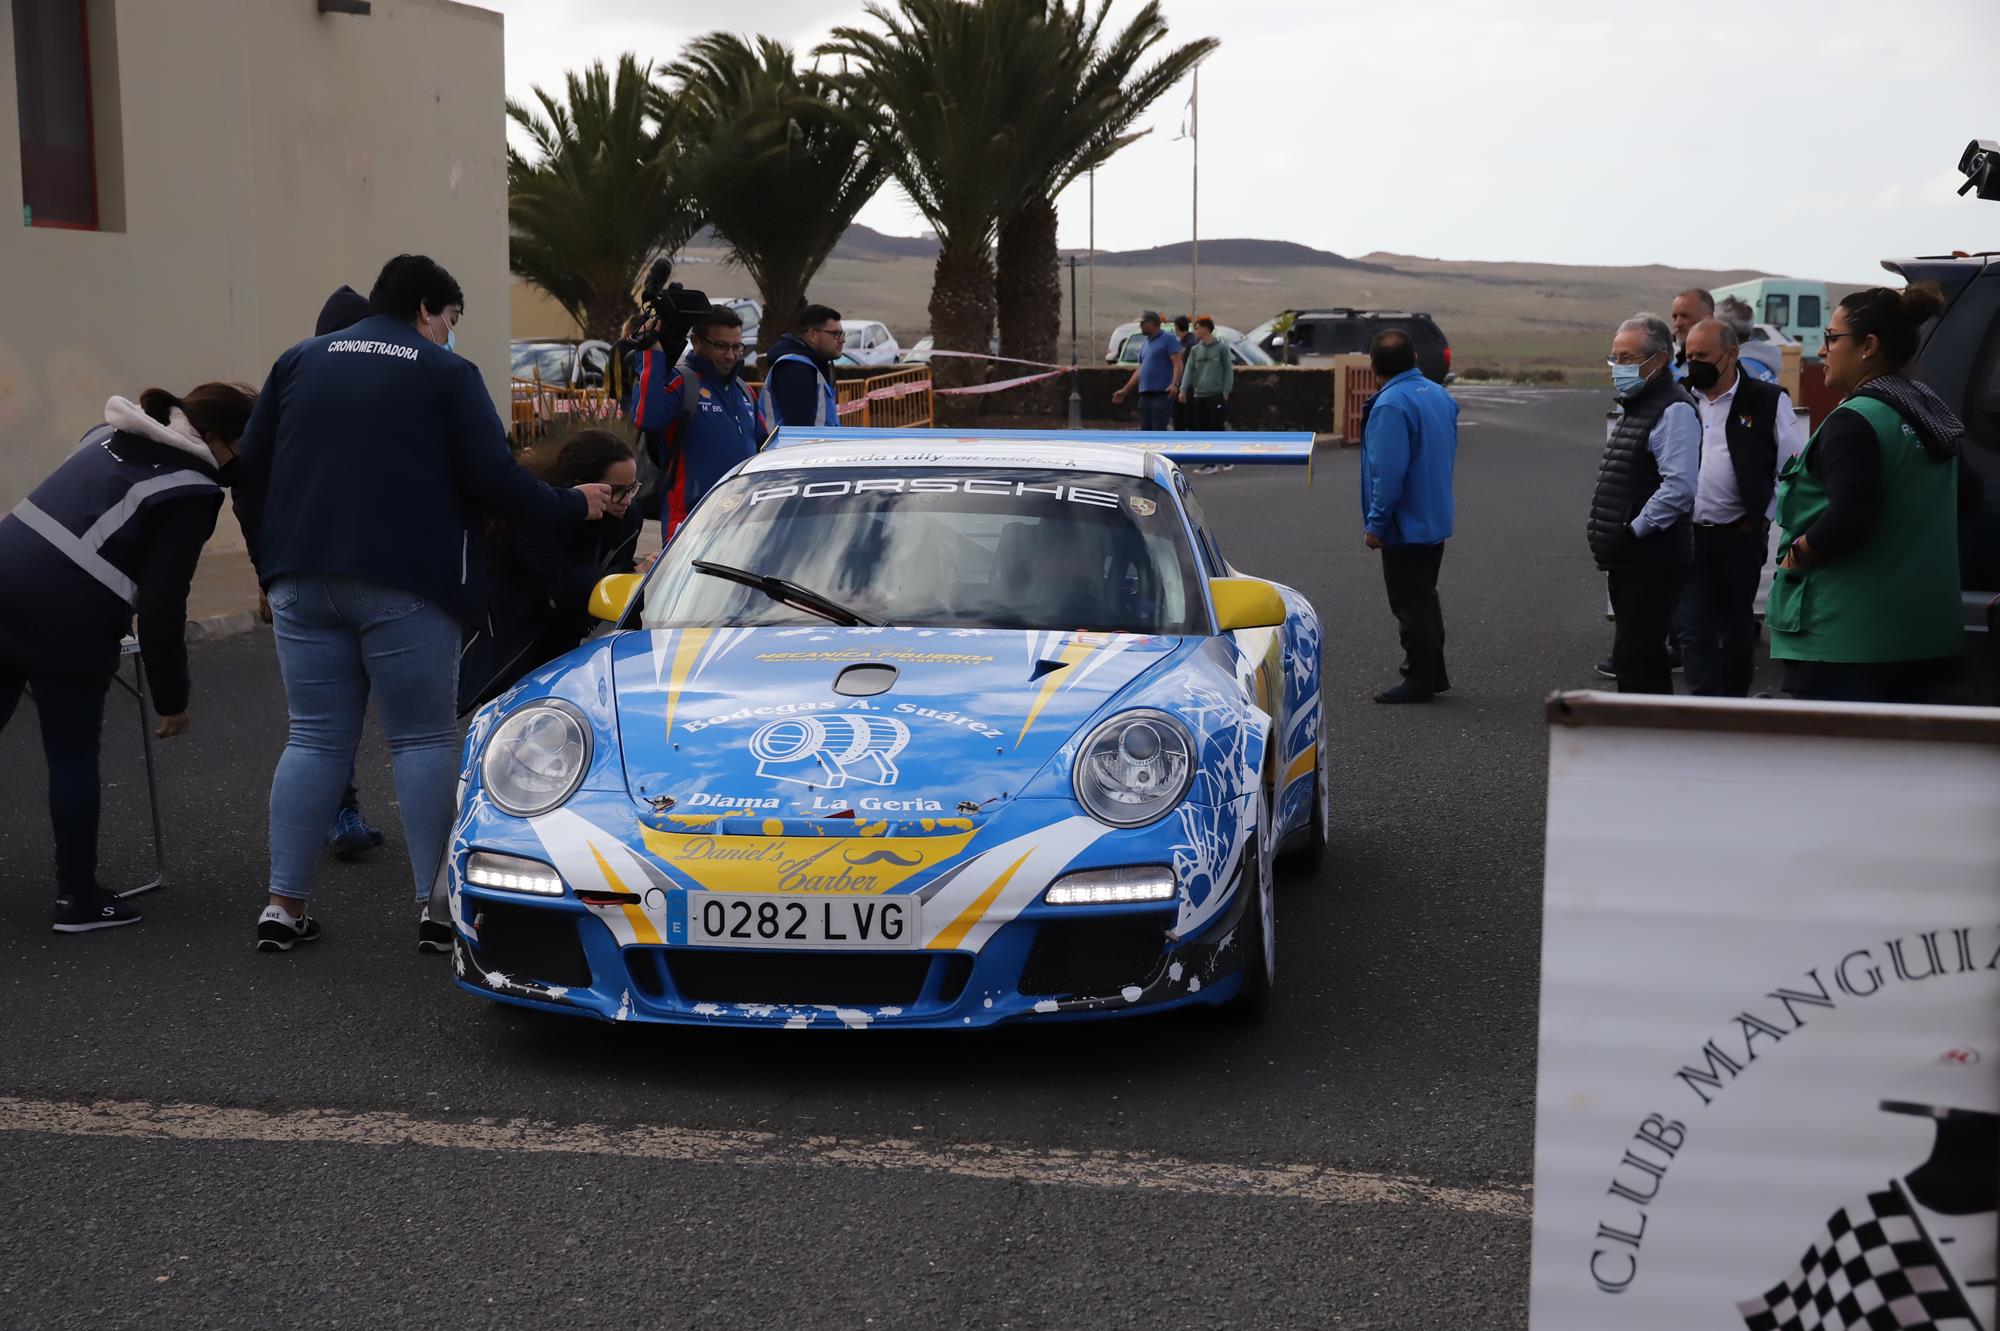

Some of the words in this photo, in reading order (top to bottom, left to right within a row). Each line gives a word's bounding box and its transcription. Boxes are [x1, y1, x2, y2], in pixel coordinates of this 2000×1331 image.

[327, 340, 419, 361] CRONOMETRADORA
[836, 453, 886, 462] cada
[893, 452, 944, 462] rally
[750, 478, 1120, 509] PORSCHE
[877, 651, 994, 662] FIGUEROA
[682, 700, 836, 734] Bodegas
[853, 699, 881, 711] A.
[893, 703, 1005, 739] Suárez
[686, 792, 780, 809] Diama
[812, 796, 849, 811] La
[866, 797, 944, 811] Geria
[674, 836, 786, 862] Daniel's
[672, 922, 682, 933] E
[703, 899, 807, 941] 0282
[823, 901, 904, 941] LVG
[1590, 1112, 1687, 1295] CLUB
